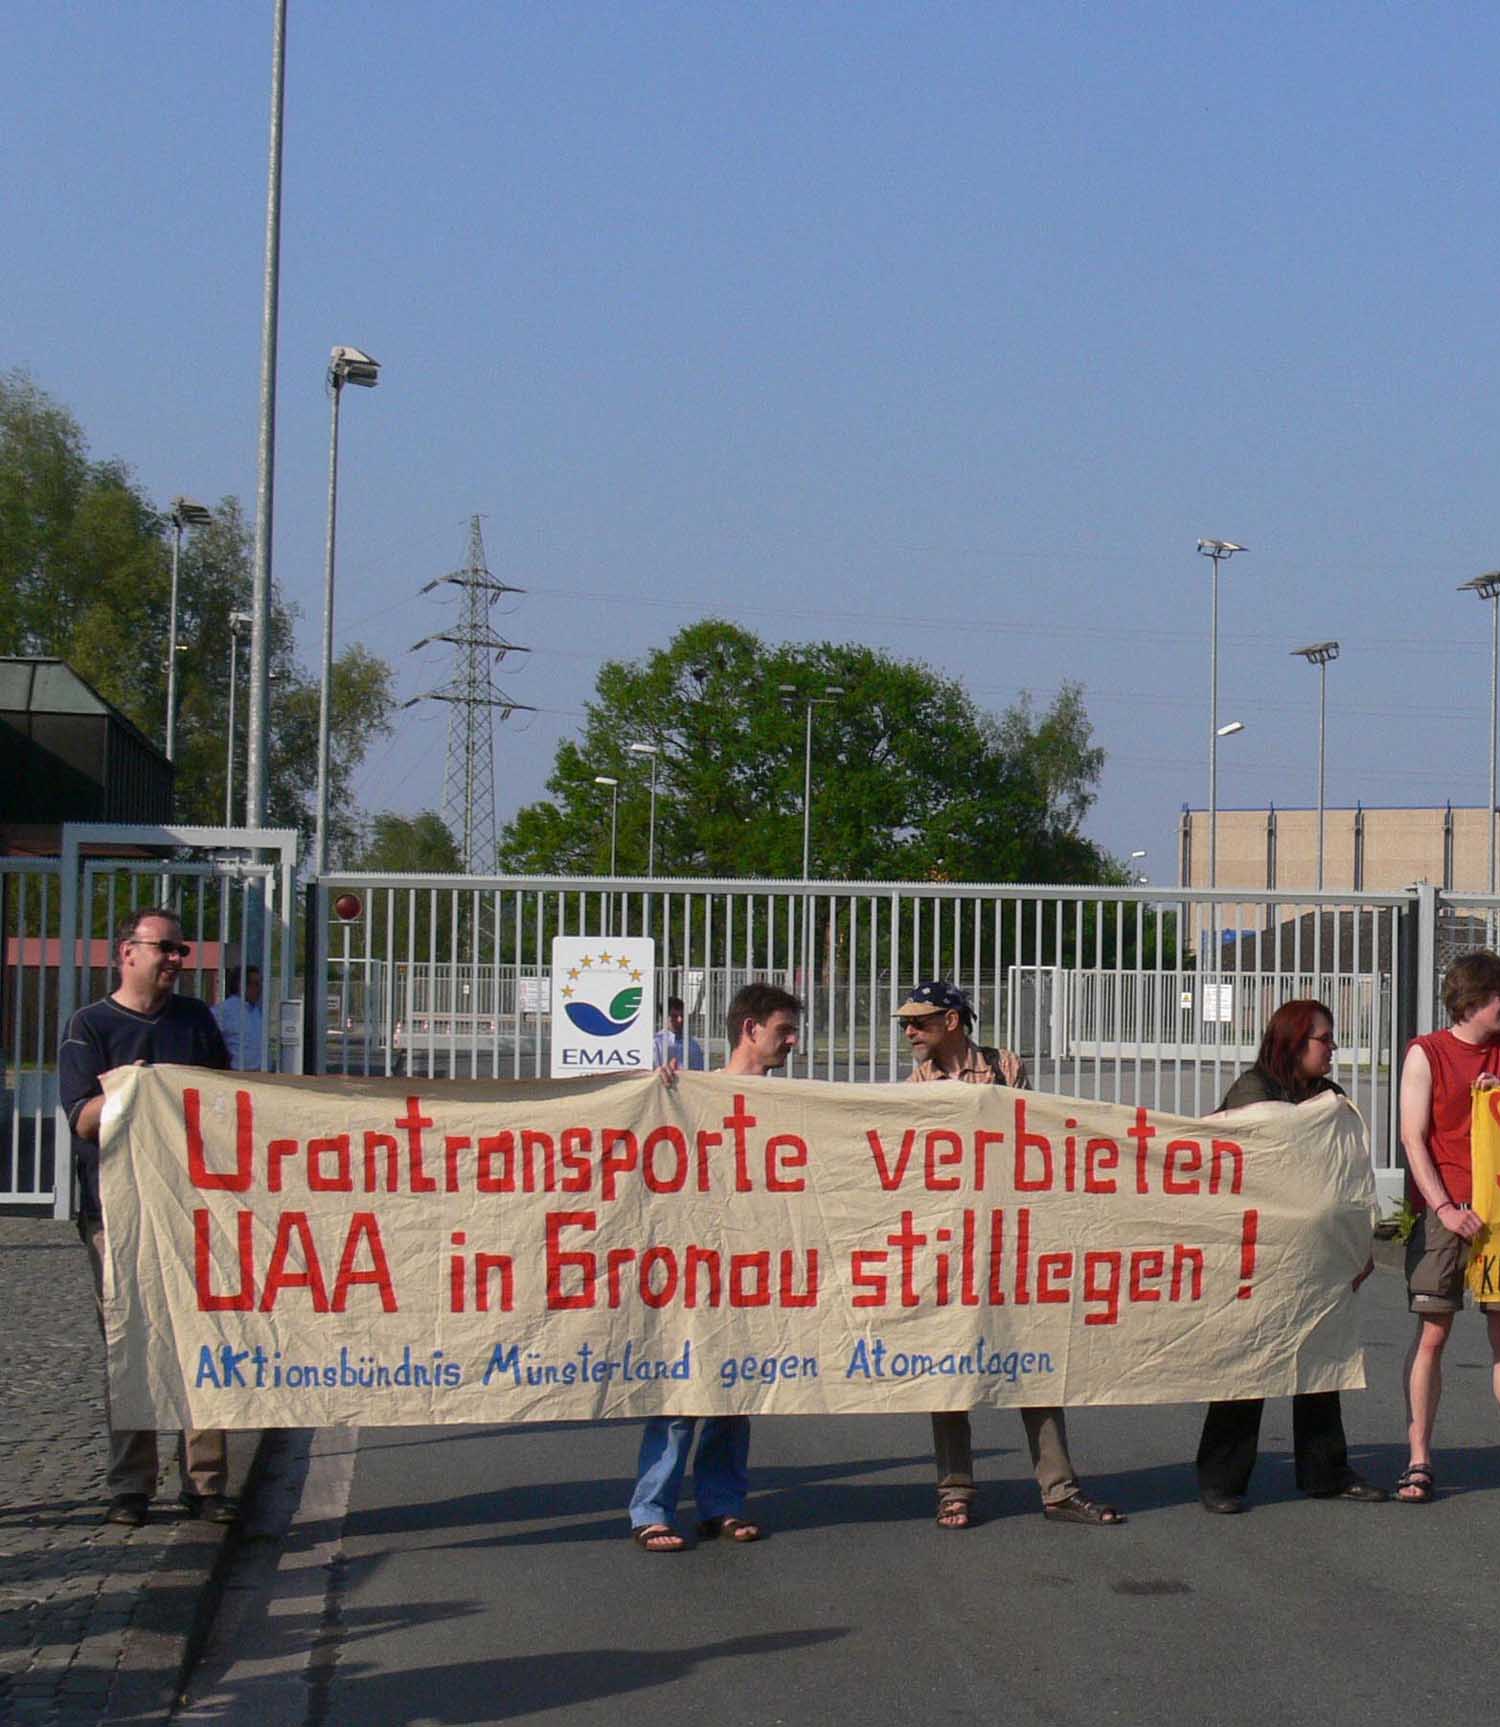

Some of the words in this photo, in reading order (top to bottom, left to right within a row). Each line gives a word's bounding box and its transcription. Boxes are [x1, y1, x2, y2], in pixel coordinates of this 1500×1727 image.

[562, 1048, 641, 1066] EMAS
[183, 1088, 806, 1200] Urantransporte
[866, 1098, 1244, 1195] verbieten
[192, 1208, 399, 1314] UAA
[449, 1231, 514, 1313] in
[545, 1210, 819, 1311] Gronau
[850, 1208, 1203, 1326] stilllegen
[481, 1338, 692, 1388] Münsterland
[720, 1350, 819, 1388] gegen
[846, 1336, 1055, 1382] Atomanlagen
